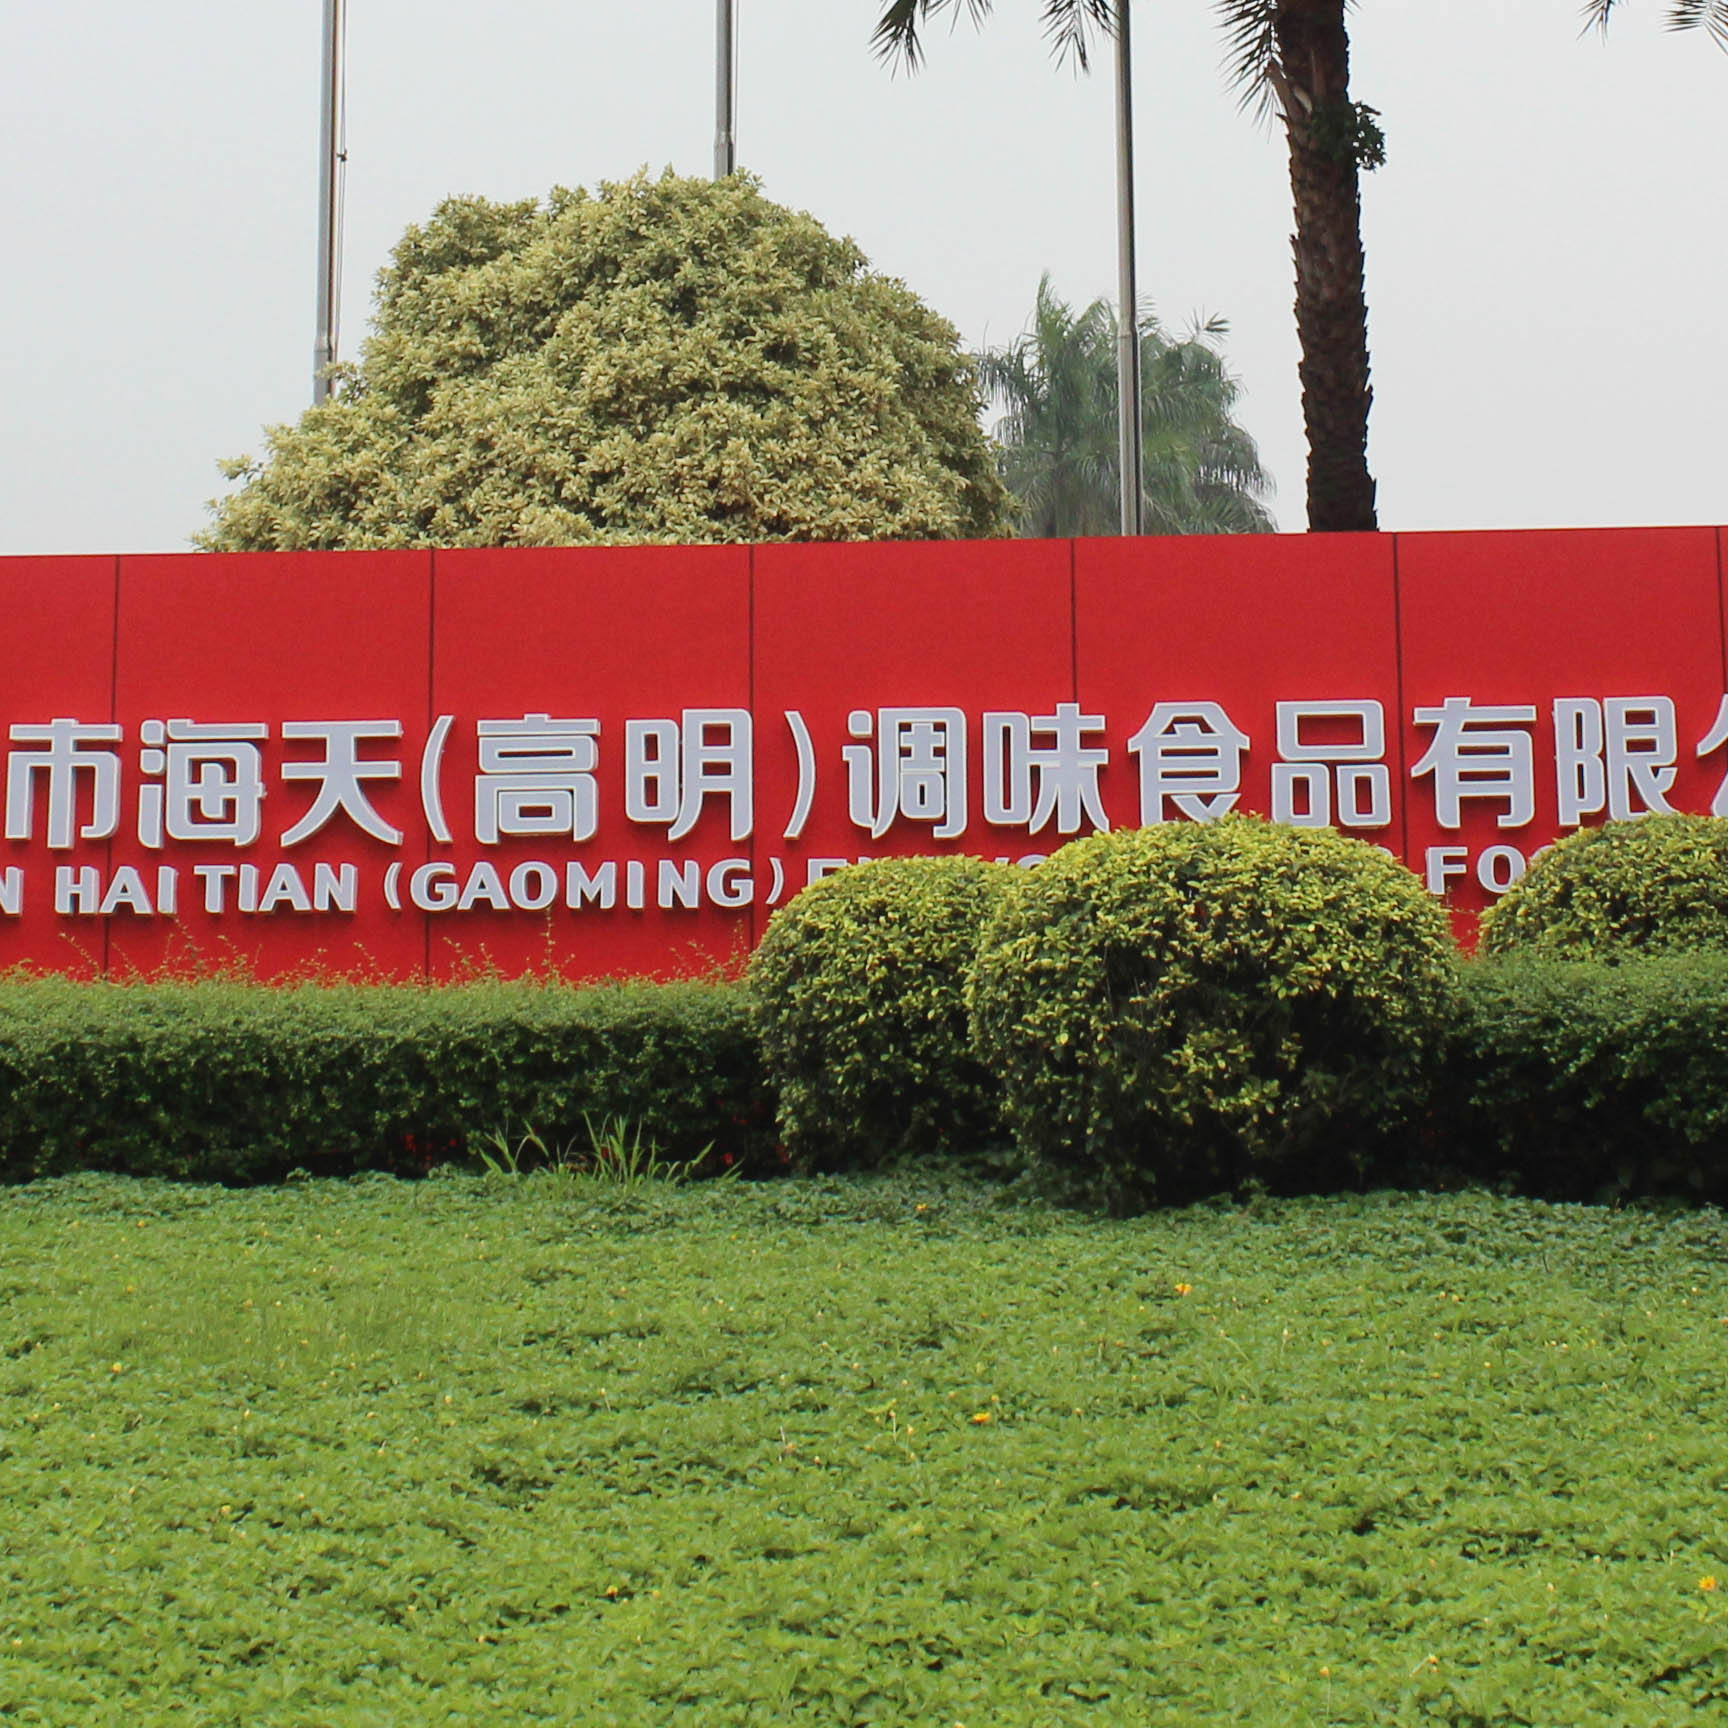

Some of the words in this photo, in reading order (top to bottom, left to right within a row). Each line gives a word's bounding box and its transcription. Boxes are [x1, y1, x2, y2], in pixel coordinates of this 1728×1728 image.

[54, 864, 178, 915] HAI
[193, 862, 358, 914] TIAN
[383, 856, 785, 912] (GAOMING)
